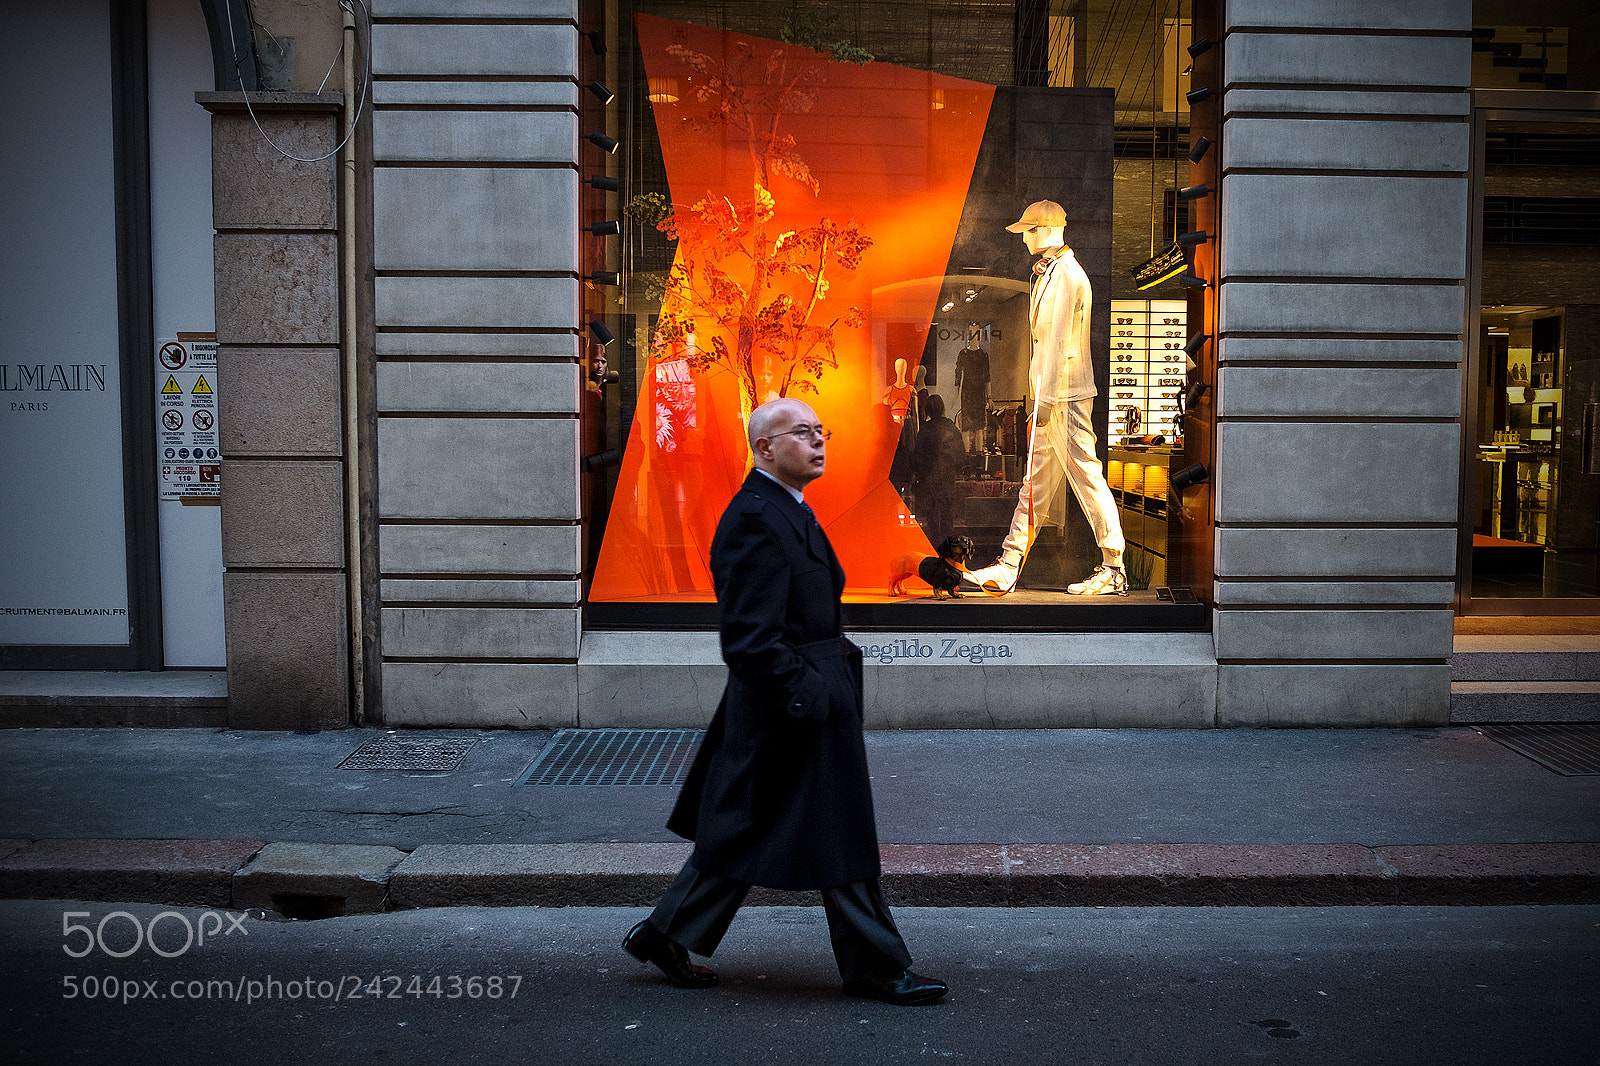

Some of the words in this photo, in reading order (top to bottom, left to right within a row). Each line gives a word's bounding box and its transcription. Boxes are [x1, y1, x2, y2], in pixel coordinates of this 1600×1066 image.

[0, 364, 107, 391] LMAIN
[11, 403, 49, 411] PARIS
[939, 638, 1013, 665] Zegna
